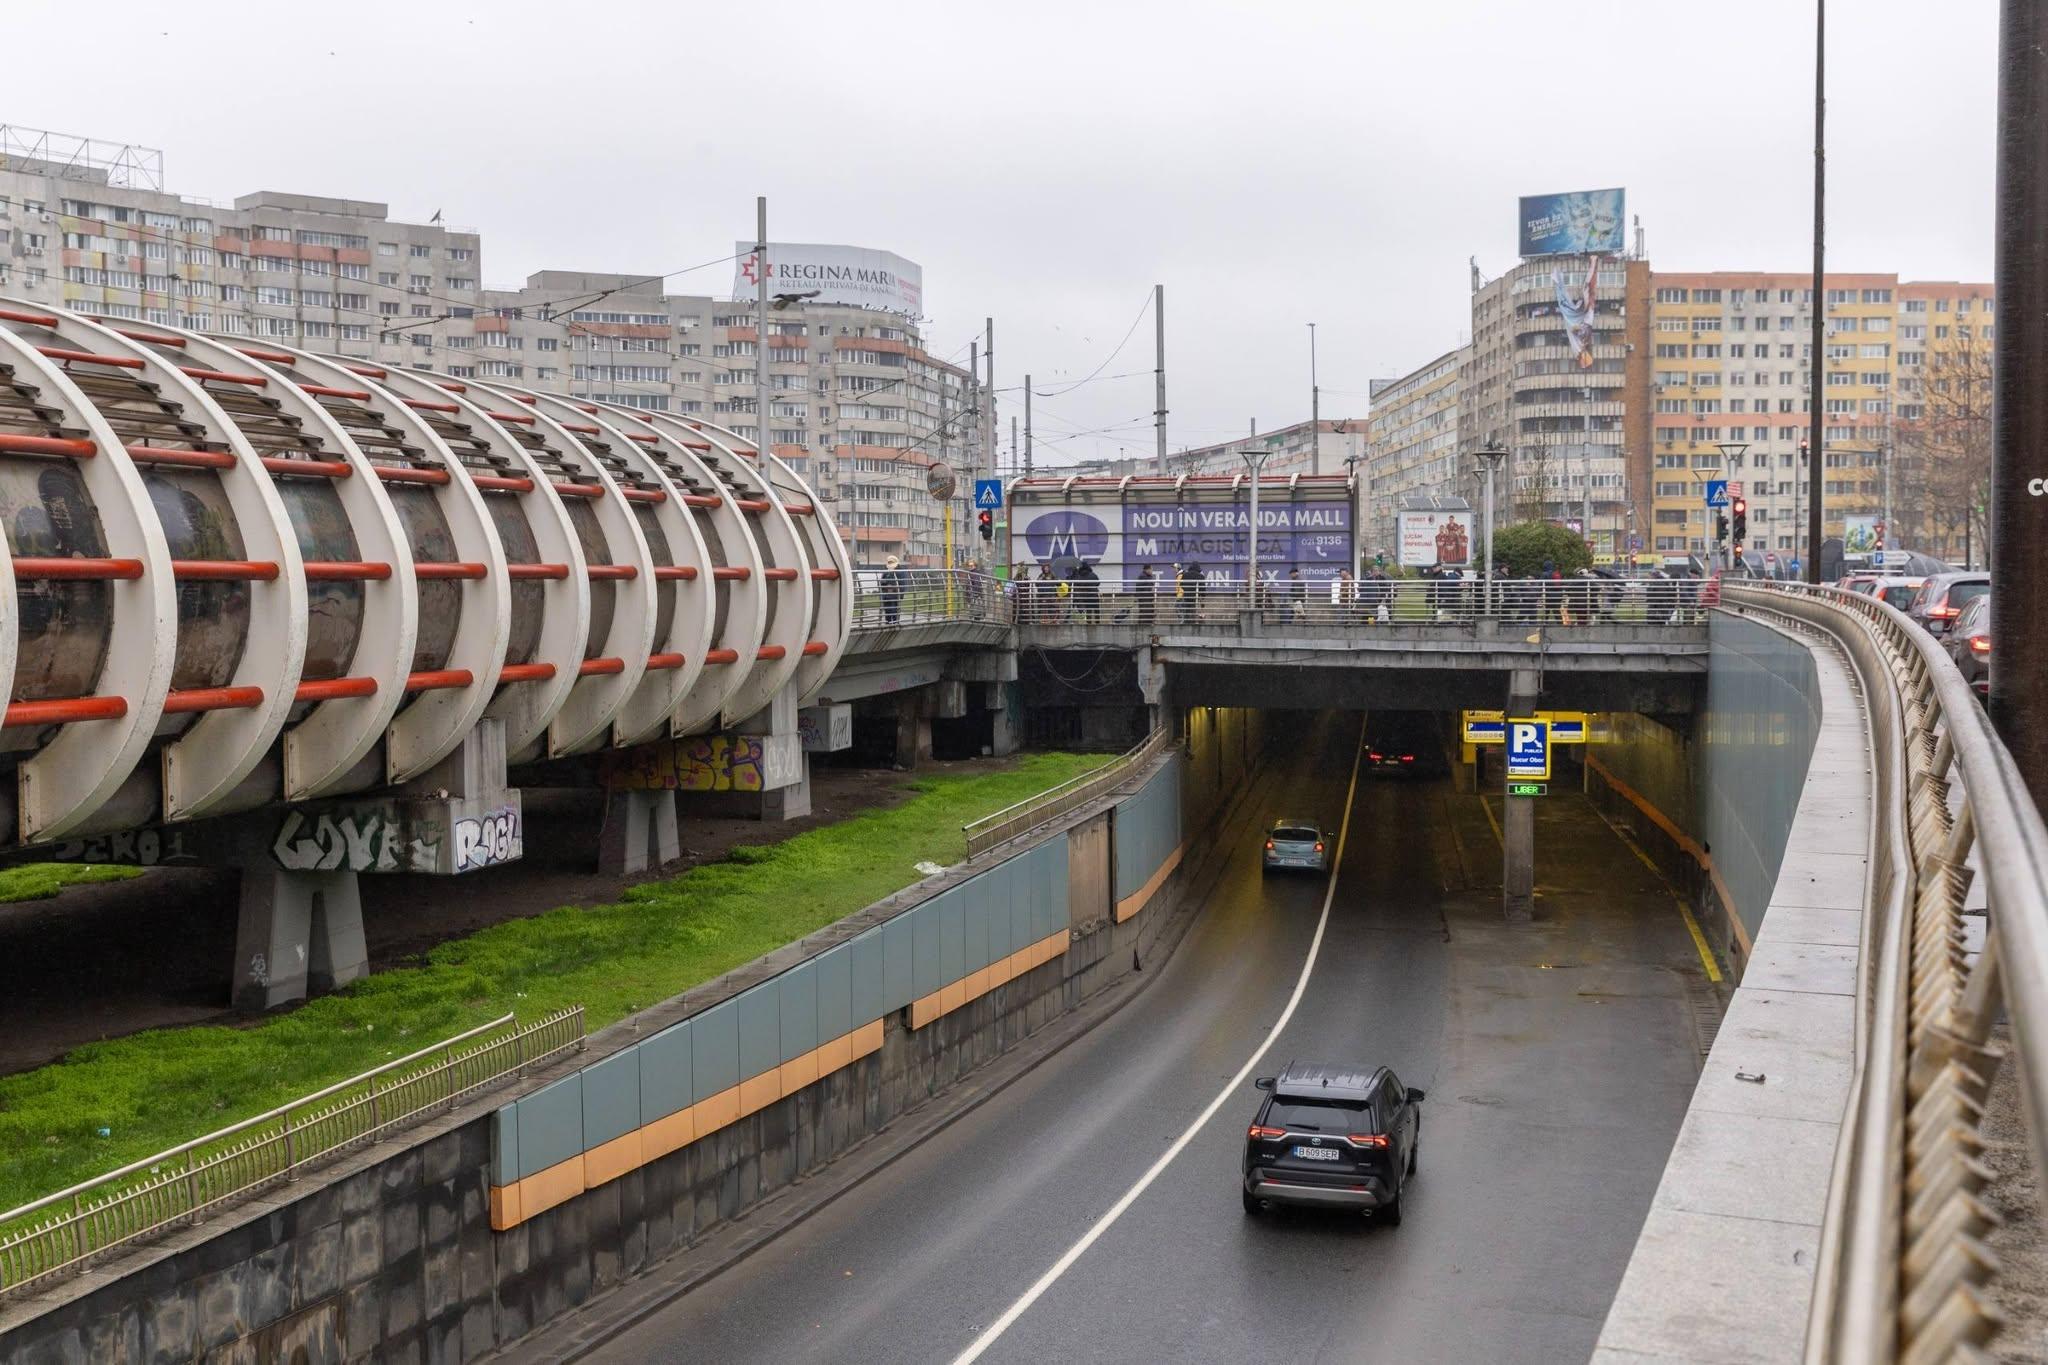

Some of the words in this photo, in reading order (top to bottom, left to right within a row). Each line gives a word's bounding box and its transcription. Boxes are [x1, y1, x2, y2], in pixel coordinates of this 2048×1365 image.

[780, 264, 853, 280] REGINA
[1133, 512, 1173, 528] NOU
[1177, 507, 1197, 528] ÎN
[1201, 511, 1290, 527] VERANDA
[1295, 510, 1344, 526] MALL
[1136, 539, 1158, 556] M
[1162, 537, 1282, 553] IMAGISTCĂ
[1316, 536, 1342, 545] 9136
[1513, 725, 1537, 753] P
[1515, 786, 1538, 794] LIBER
